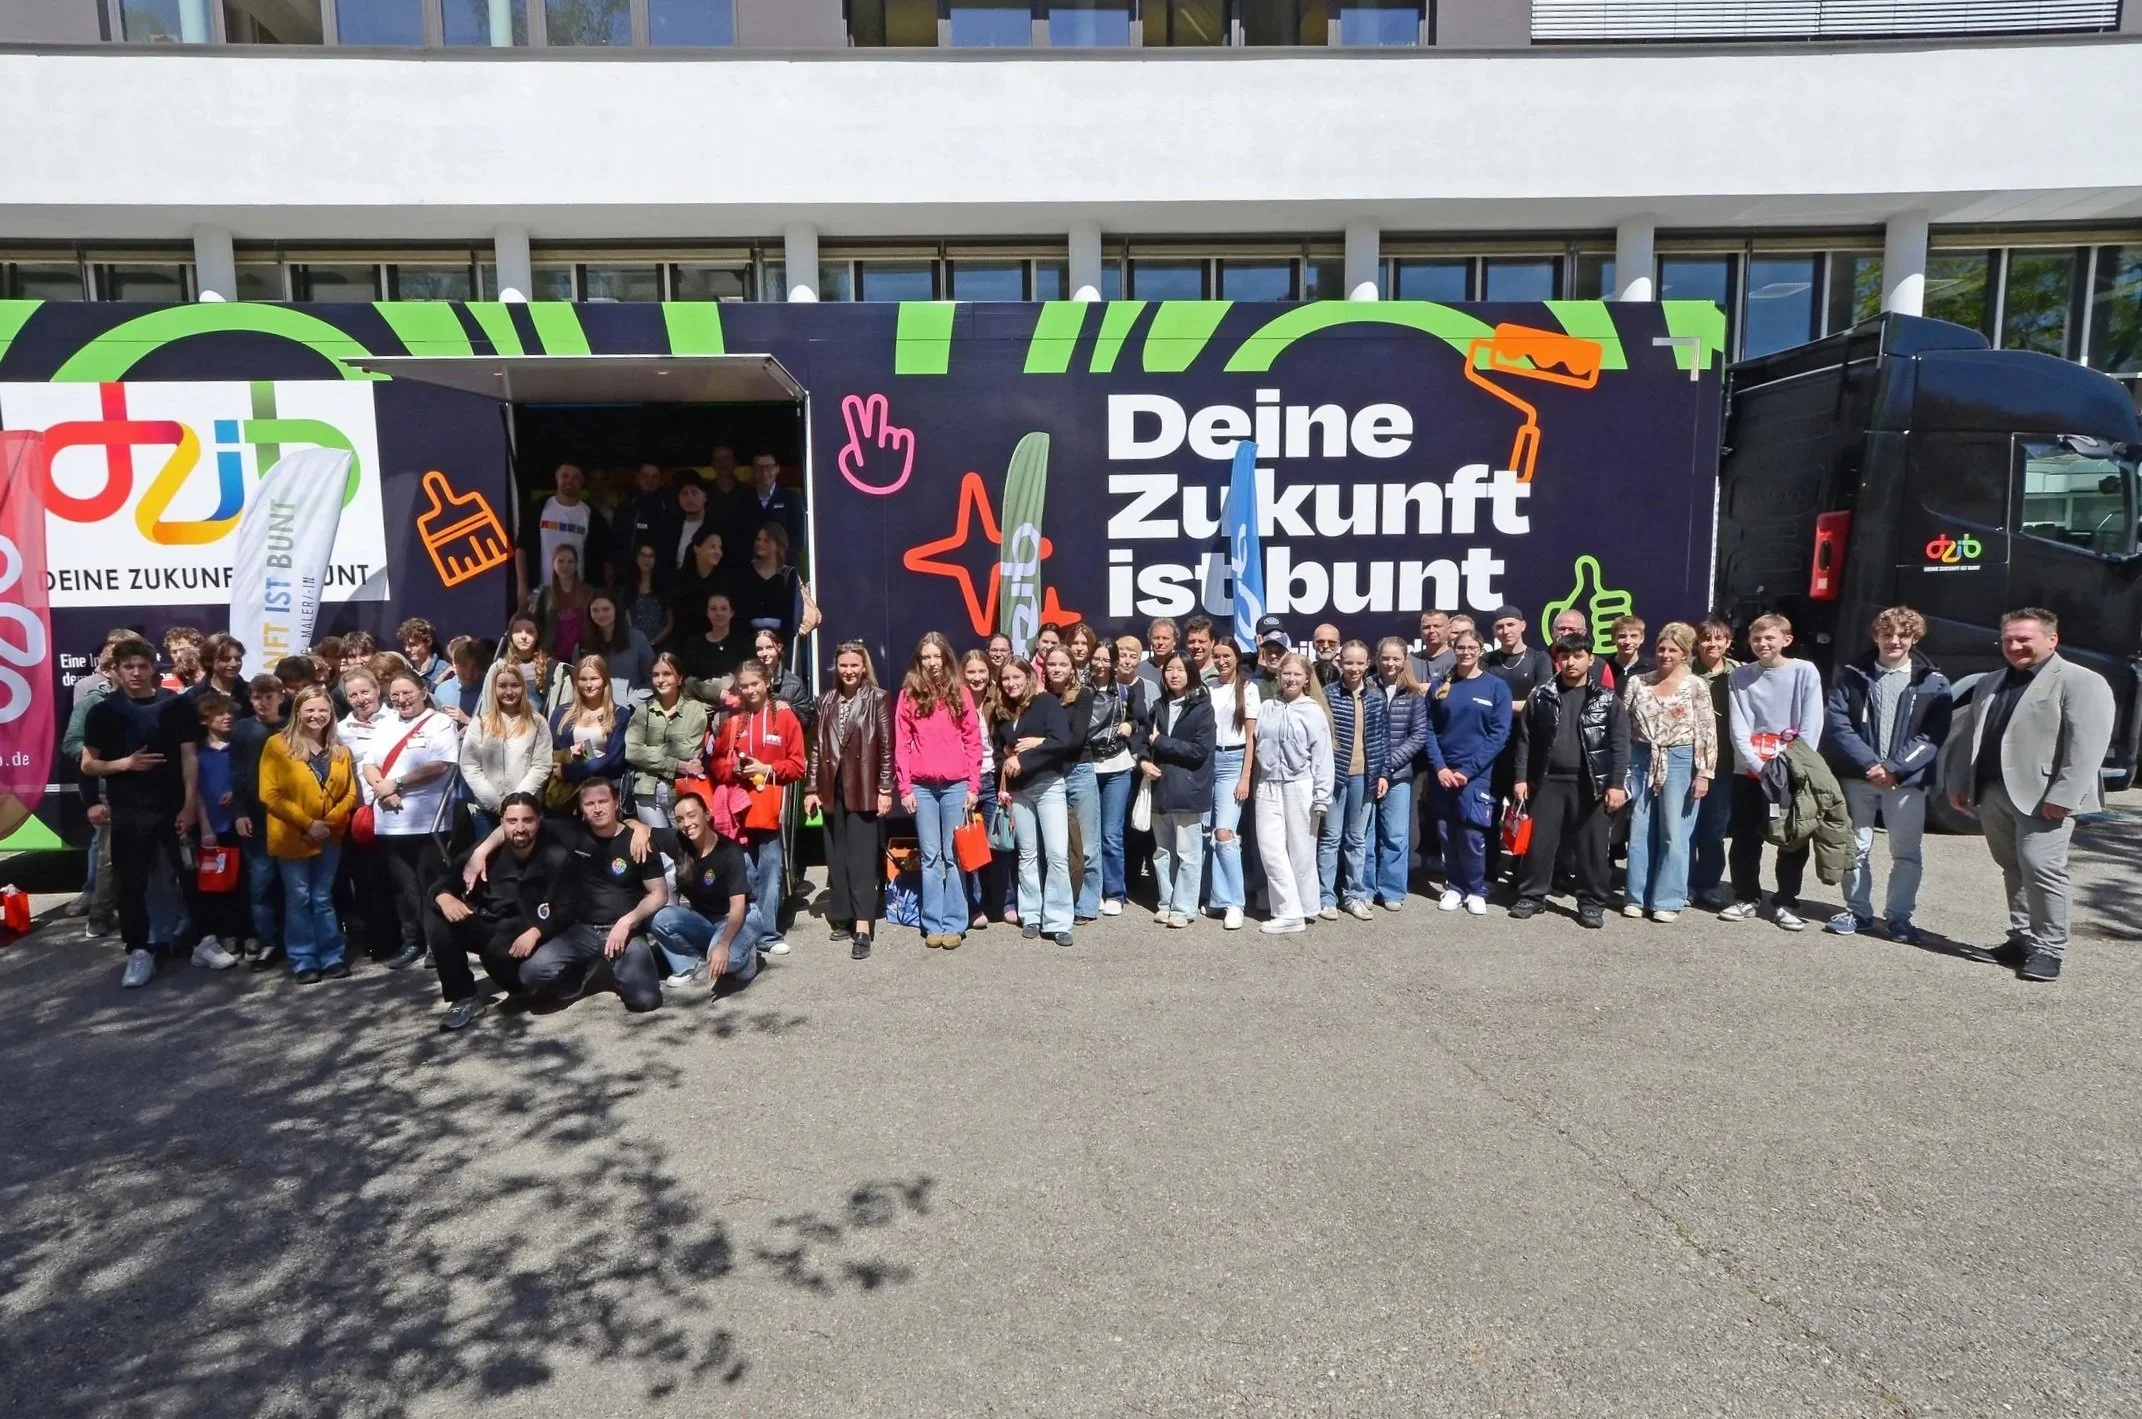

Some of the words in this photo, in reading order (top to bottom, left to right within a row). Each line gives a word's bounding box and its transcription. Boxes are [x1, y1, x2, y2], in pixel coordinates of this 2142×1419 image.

[1107, 389, 1413, 460] Deine
[266, 498, 297, 569] BUNT
[1107, 463, 1531, 539] Zukunft
[39, 569, 119, 591] DEINE
[129, 567, 234, 590] ZUKUNF
[323, 564, 368, 587] UNT
[264, 576, 292, 613] IST
[1109, 548, 1234, 617] ist
[1265, 546, 1505, 614] bunt
[60, 653, 87, 669] Eine
